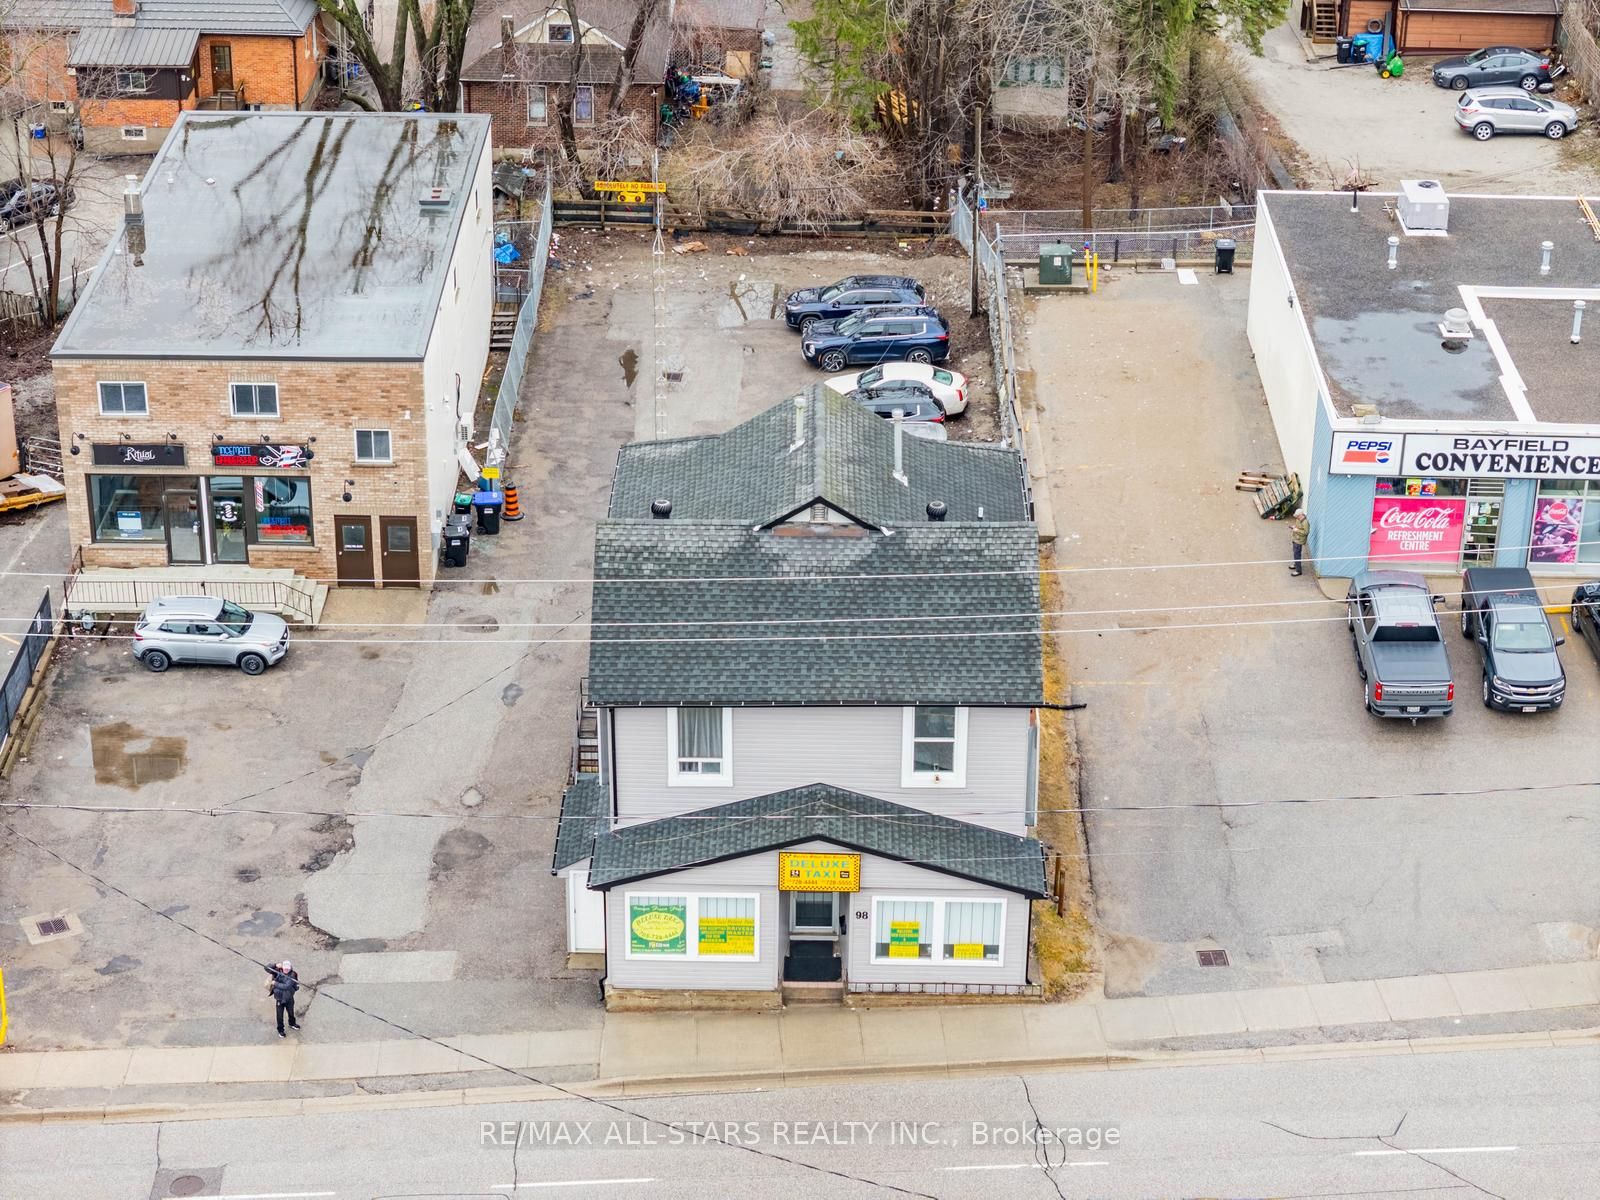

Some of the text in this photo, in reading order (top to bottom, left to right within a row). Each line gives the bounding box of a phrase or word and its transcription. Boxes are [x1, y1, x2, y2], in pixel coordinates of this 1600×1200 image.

[1347, 440, 1392, 451] PEPSI
[1453, 438, 1569, 452] BAYFIELD
[123, 446, 156, 463] Ritual
[1415, 452, 1600, 474] CONVENIENCE
[1379, 506, 1455, 529] Coca-Cola
[1387, 530, 1444, 542] REFRESHMENT
[1400, 541, 1430, 551] CENTRE
[790, 860, 849, 869] DELUXE
[806, 870, 837, 878] TAXI
[855, 911, 868, 920] 98
